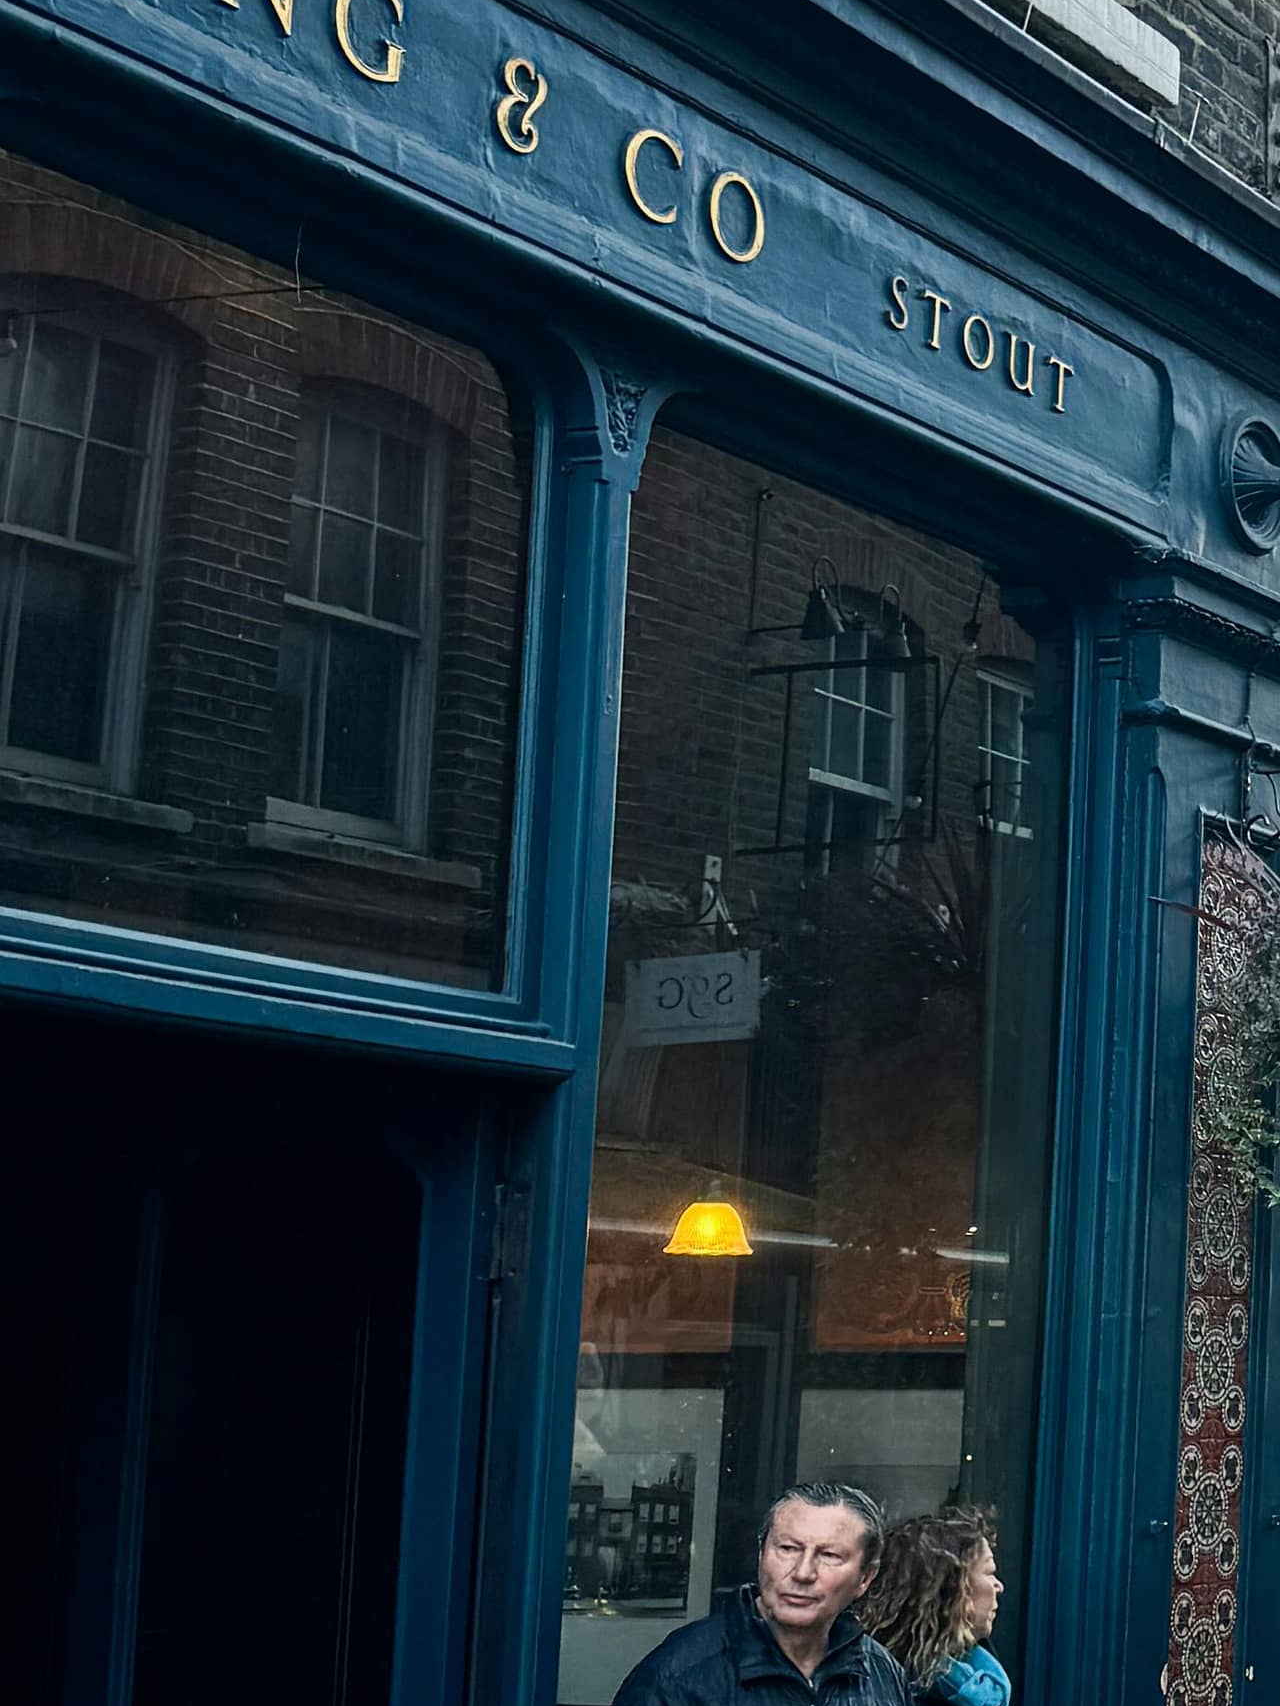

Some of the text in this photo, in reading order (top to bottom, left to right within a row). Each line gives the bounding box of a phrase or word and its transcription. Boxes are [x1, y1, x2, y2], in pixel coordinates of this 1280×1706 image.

[497, 58, 548, 153] &
[625, 129, 766, 263] CO
[887, 275, 1075, 413] STOUT
